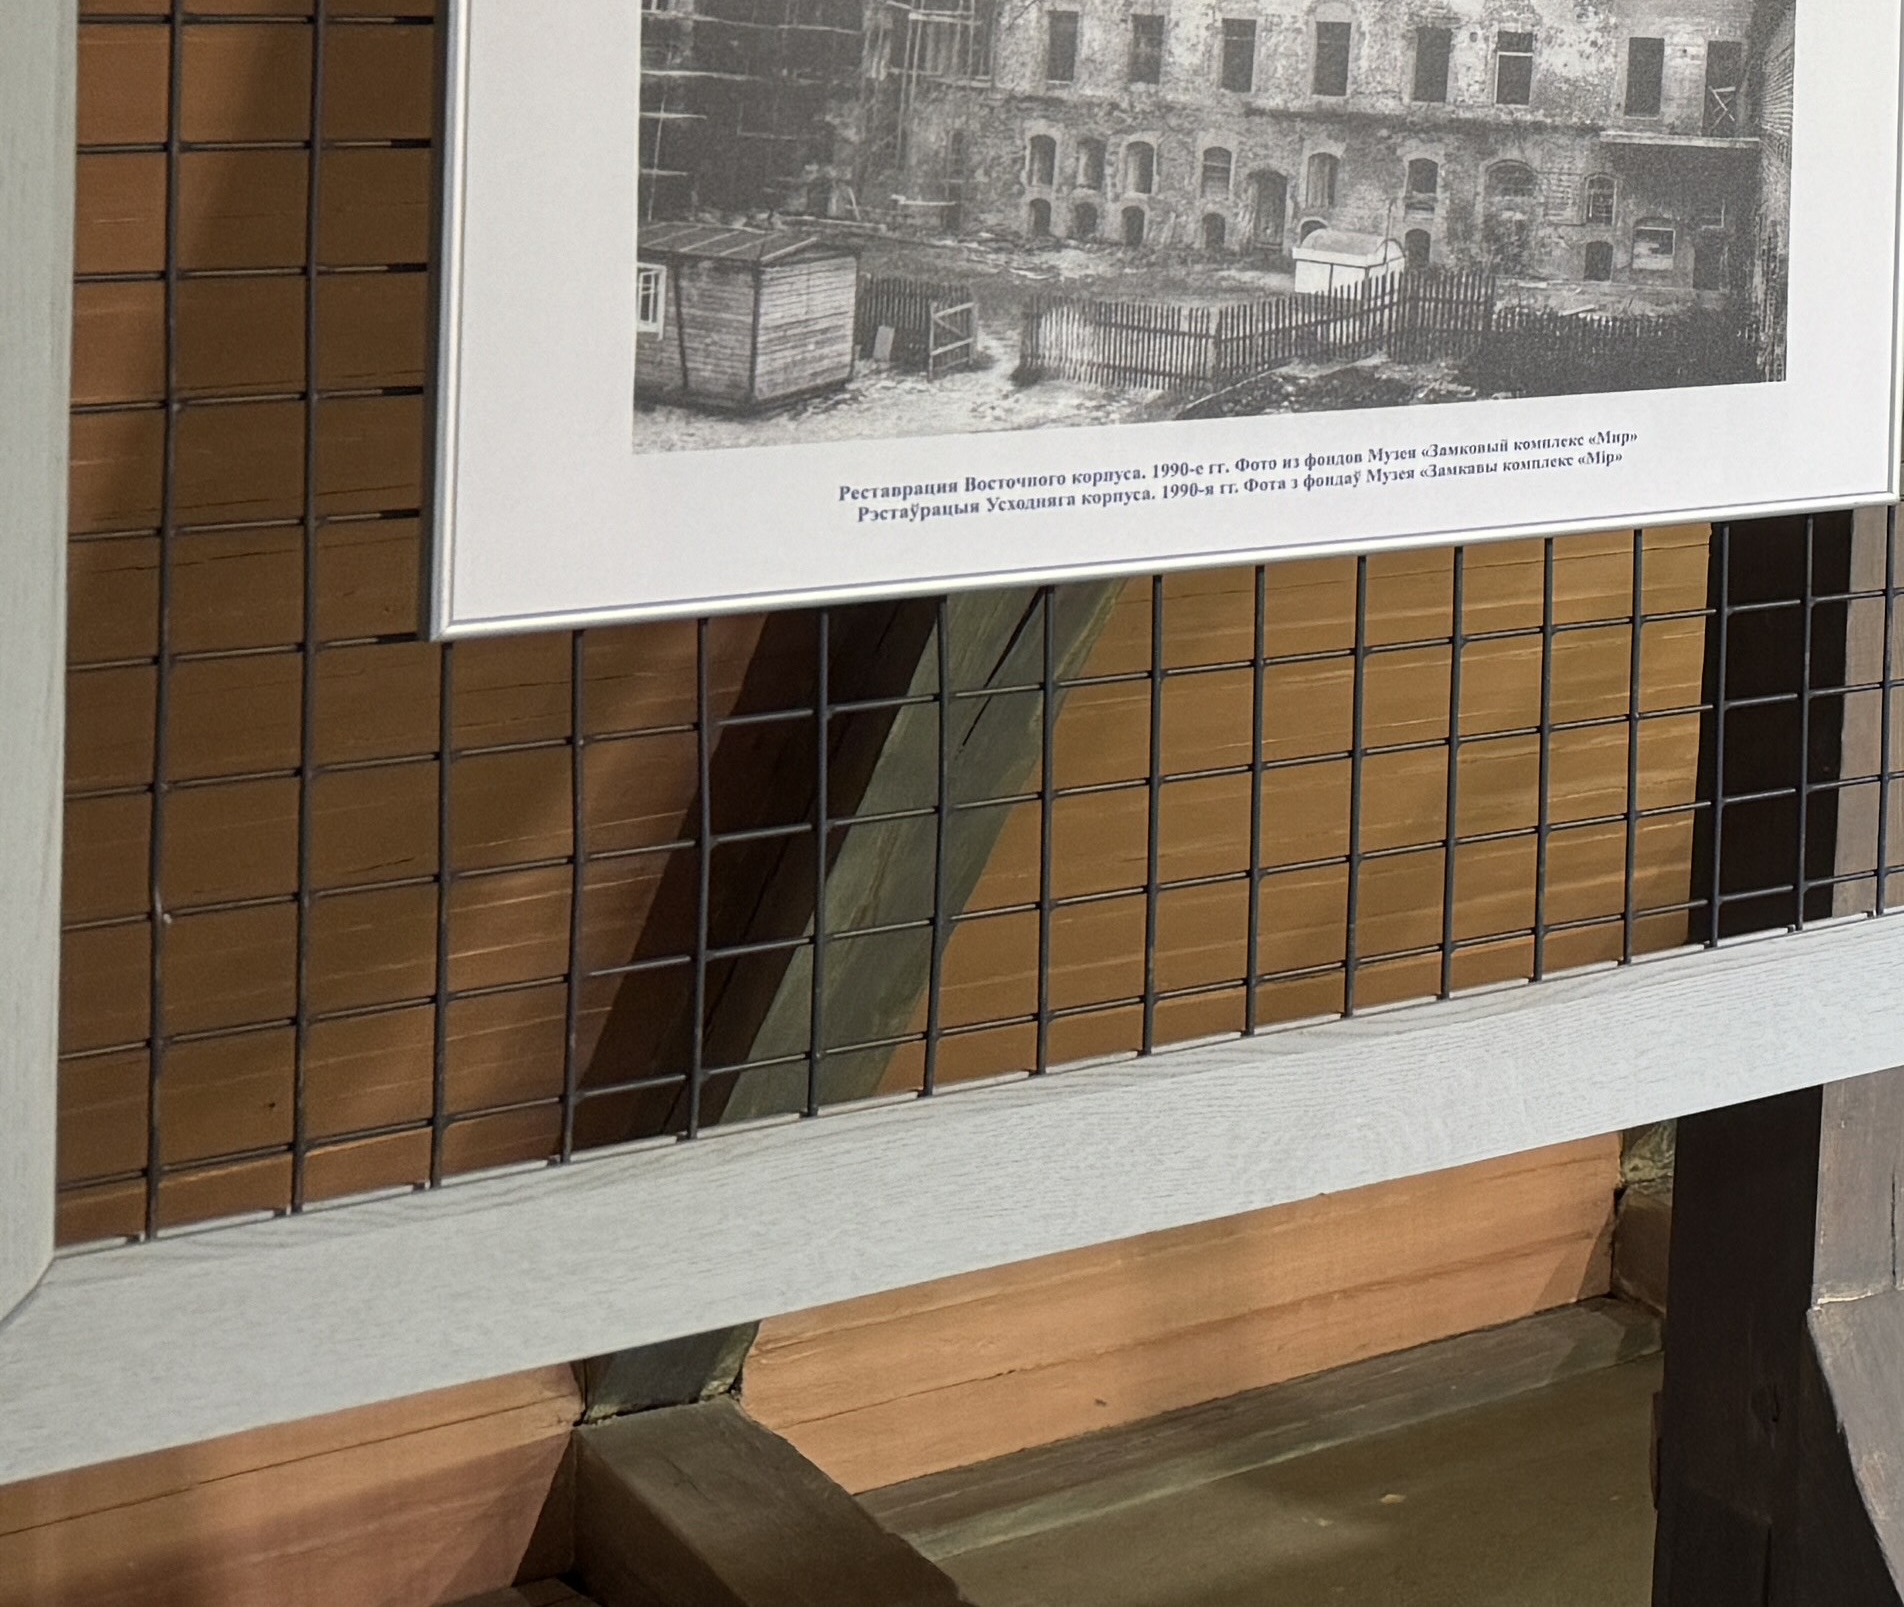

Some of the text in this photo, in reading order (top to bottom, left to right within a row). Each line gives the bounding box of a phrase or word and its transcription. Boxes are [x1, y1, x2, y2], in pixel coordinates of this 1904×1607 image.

[838, 481, 959, 502] Реставрация
[964, 474, 1067, 493] Восточного
[1071, 468, 1147, 488] корпуса.
[1152, 461, 1205, 479] 1990-е
[1208, 462, 1230, 475] гг.
[1234, 457, 1278, 473] Фото
[1282, 457, 1300, 470] из
[1303, 452, 1363, 472] фондов
[1367, 447, 1417, 466] Музея
[1513, 435, 1585, 452] комплекс
[1588, 430, 1638, 447] «Мир»
[857, 501, 980, 523] Рэстаўрацыя
[985, 494, 1076, 513] Усходняга
[1081, 489, 1156, 509] корпуса.
[1162, 482, 1215, 500] 1990-я
[1219, 482, 1239, 495] гг.
[1243, 477, 1287, 493] Фота
[1290, 478, 1299, 490] з
[1302, 469, 1362, 493] фондаў
[1366, 467, 1415, 486] Музея
[1502, 456, 1575, 473] комплекс
[1577, 450, 1623, 468] «Мір»
